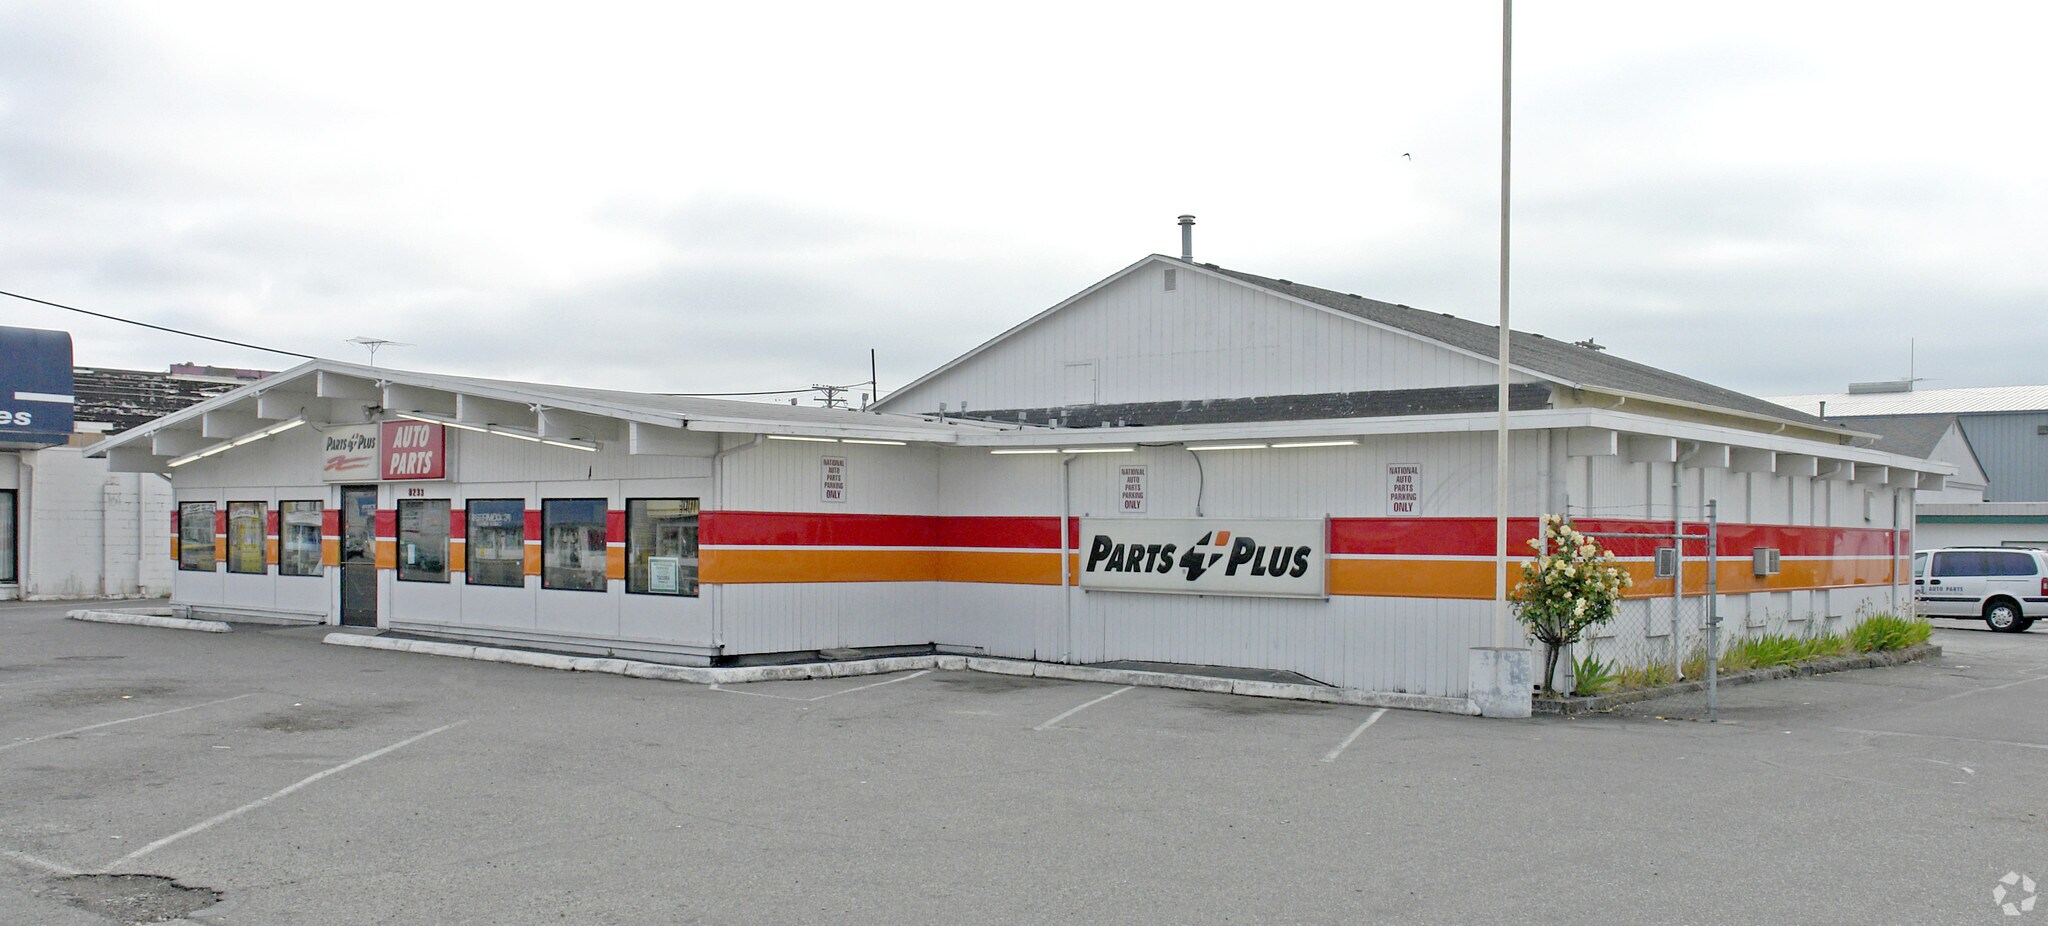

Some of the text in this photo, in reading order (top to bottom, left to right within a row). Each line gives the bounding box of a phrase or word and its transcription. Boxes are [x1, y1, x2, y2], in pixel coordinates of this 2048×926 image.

[393, 424, 430, 449] AUTO
[326, 434, 376, 451] PARTS PLUS
[389, 450, 433, 475] PARTS
[1121, 468, 1145, 476] NATIONAL
[1126, 476, 1140, 484] AUTO
[1396, 475, 1412, 483] AUTO
[824, 481, 844, 489] PARKING
[1393, 484, 1414, 492] PARTS
[826, 490, 841, 499] ONLY
[1122, 491, 1144, 499] PARKING
[1390, 493, 1417, 501] PARKING
[1124, 500, 1141, 510] ONLY
[1393, 502, 1413, 512] ONLY
[1086, 534, 1312, 578] PARTS PLUS
